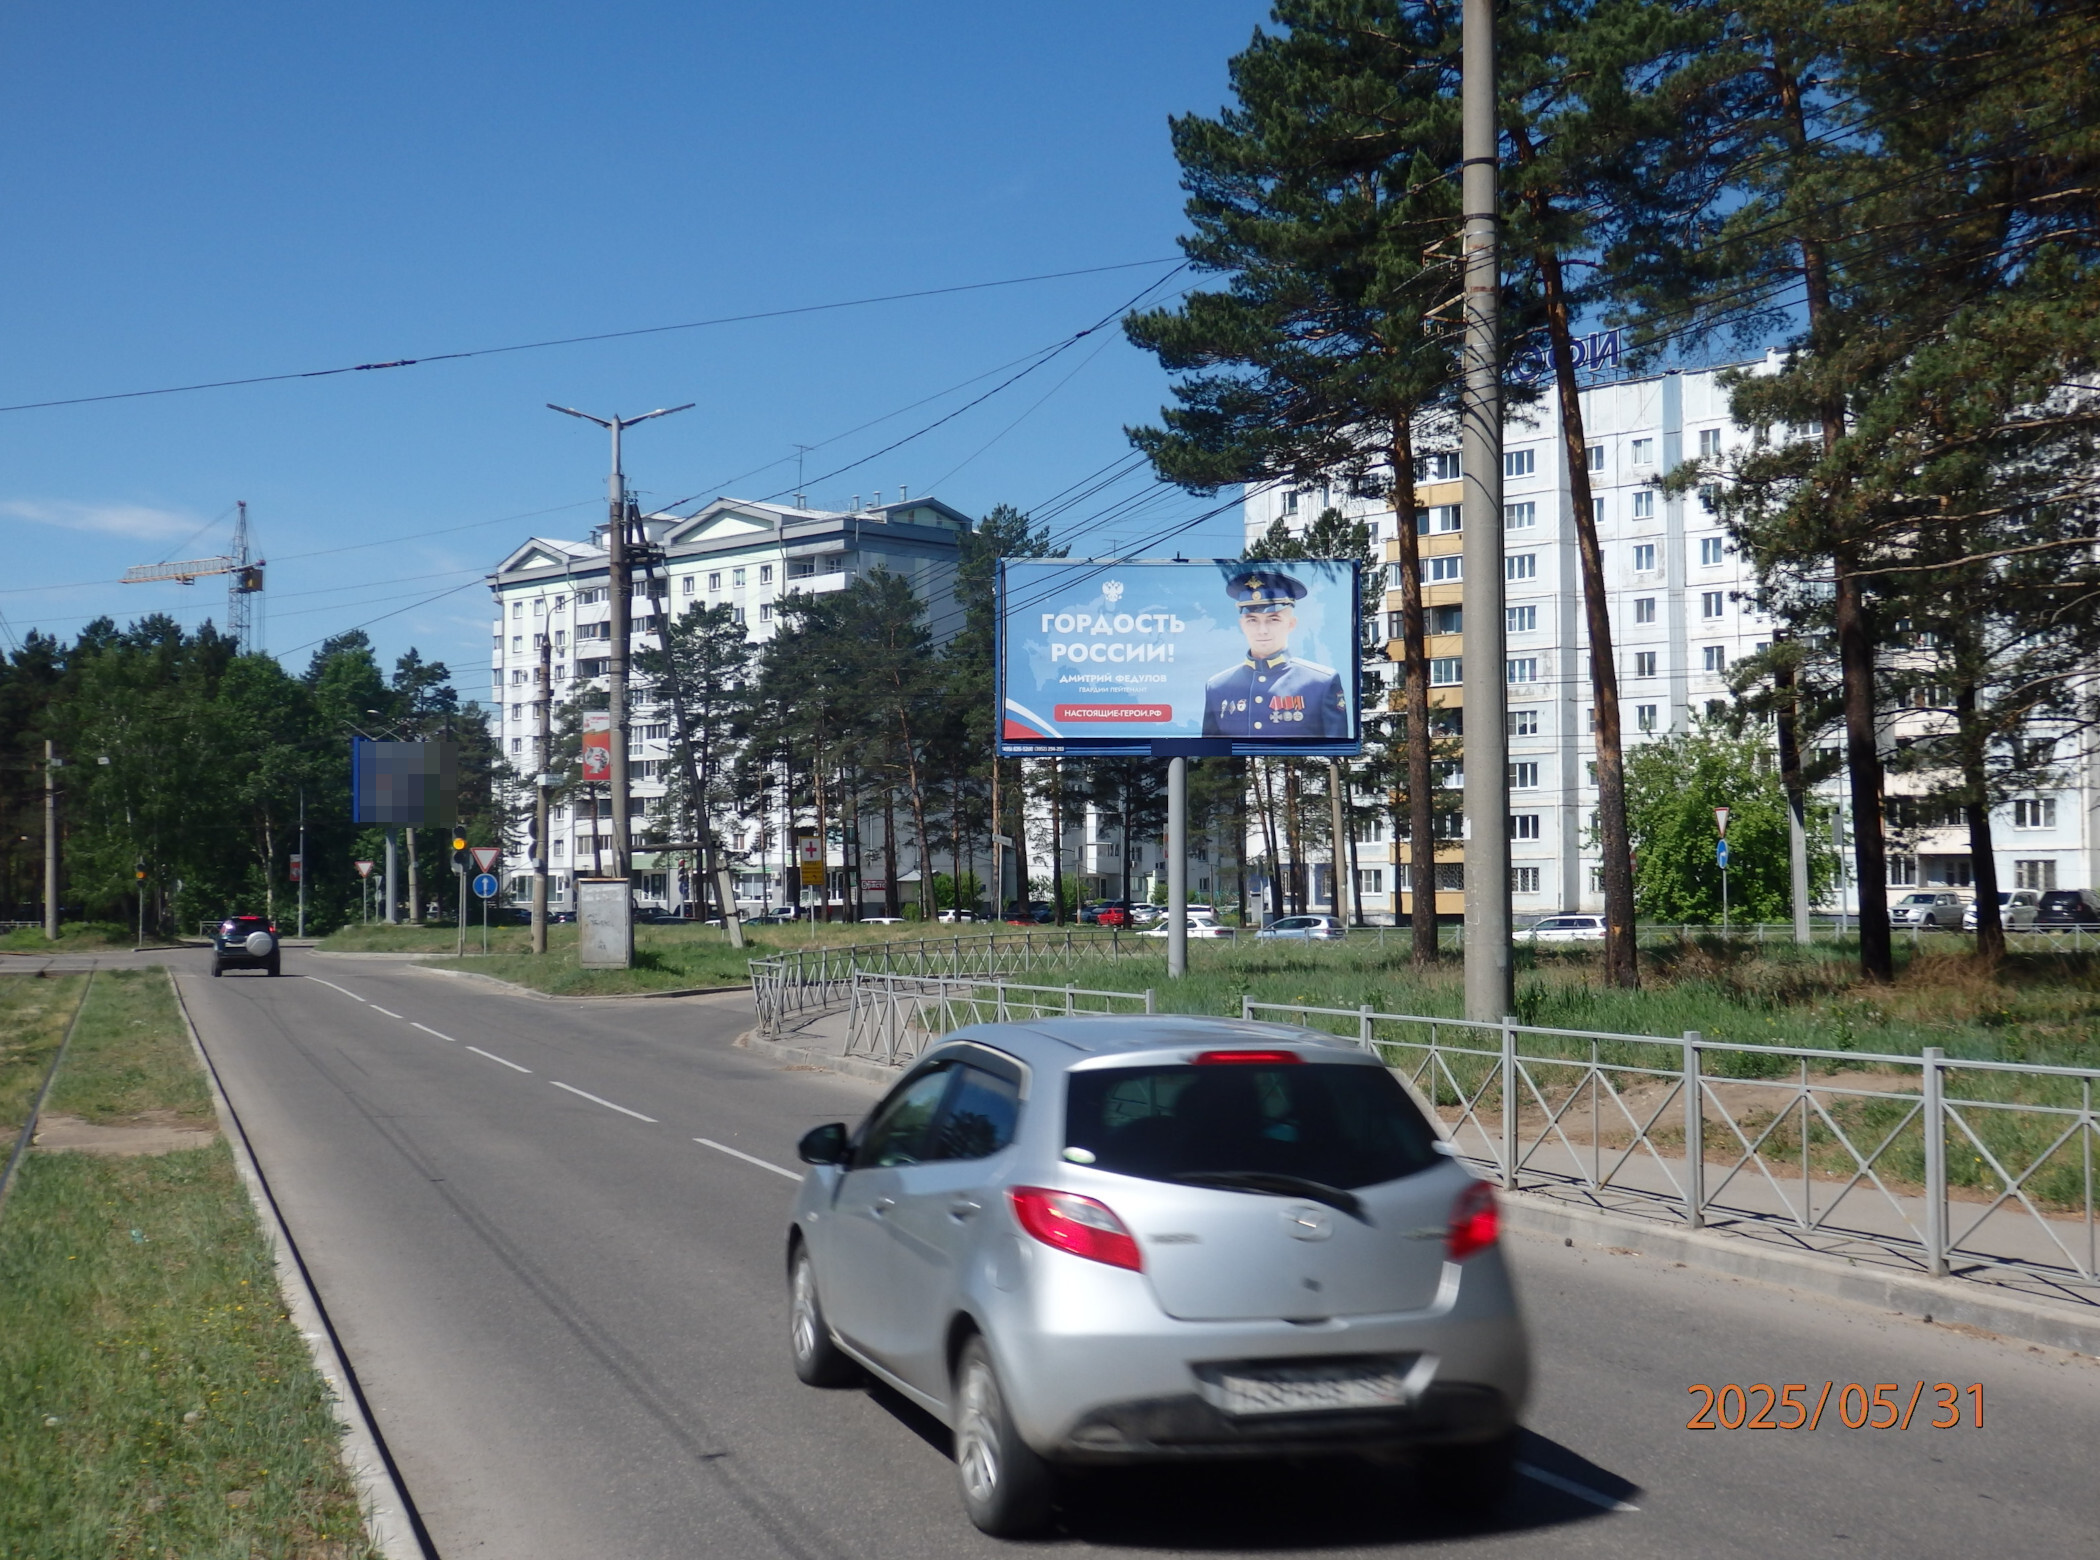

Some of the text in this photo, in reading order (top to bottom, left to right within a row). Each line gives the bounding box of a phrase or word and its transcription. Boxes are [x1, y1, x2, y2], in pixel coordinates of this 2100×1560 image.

[1041, 613, 1186, 636] ГОРДОСТЬ
[1051, 642, 1175, 663] РОССИИ!
[1059, 672, 1168, 684] ДМИТРИЙ ФЕДУЛОВ
[1064, 709, 1162, 718] НАСТОЯЩИЕ-ГЕРОИ.РФ
